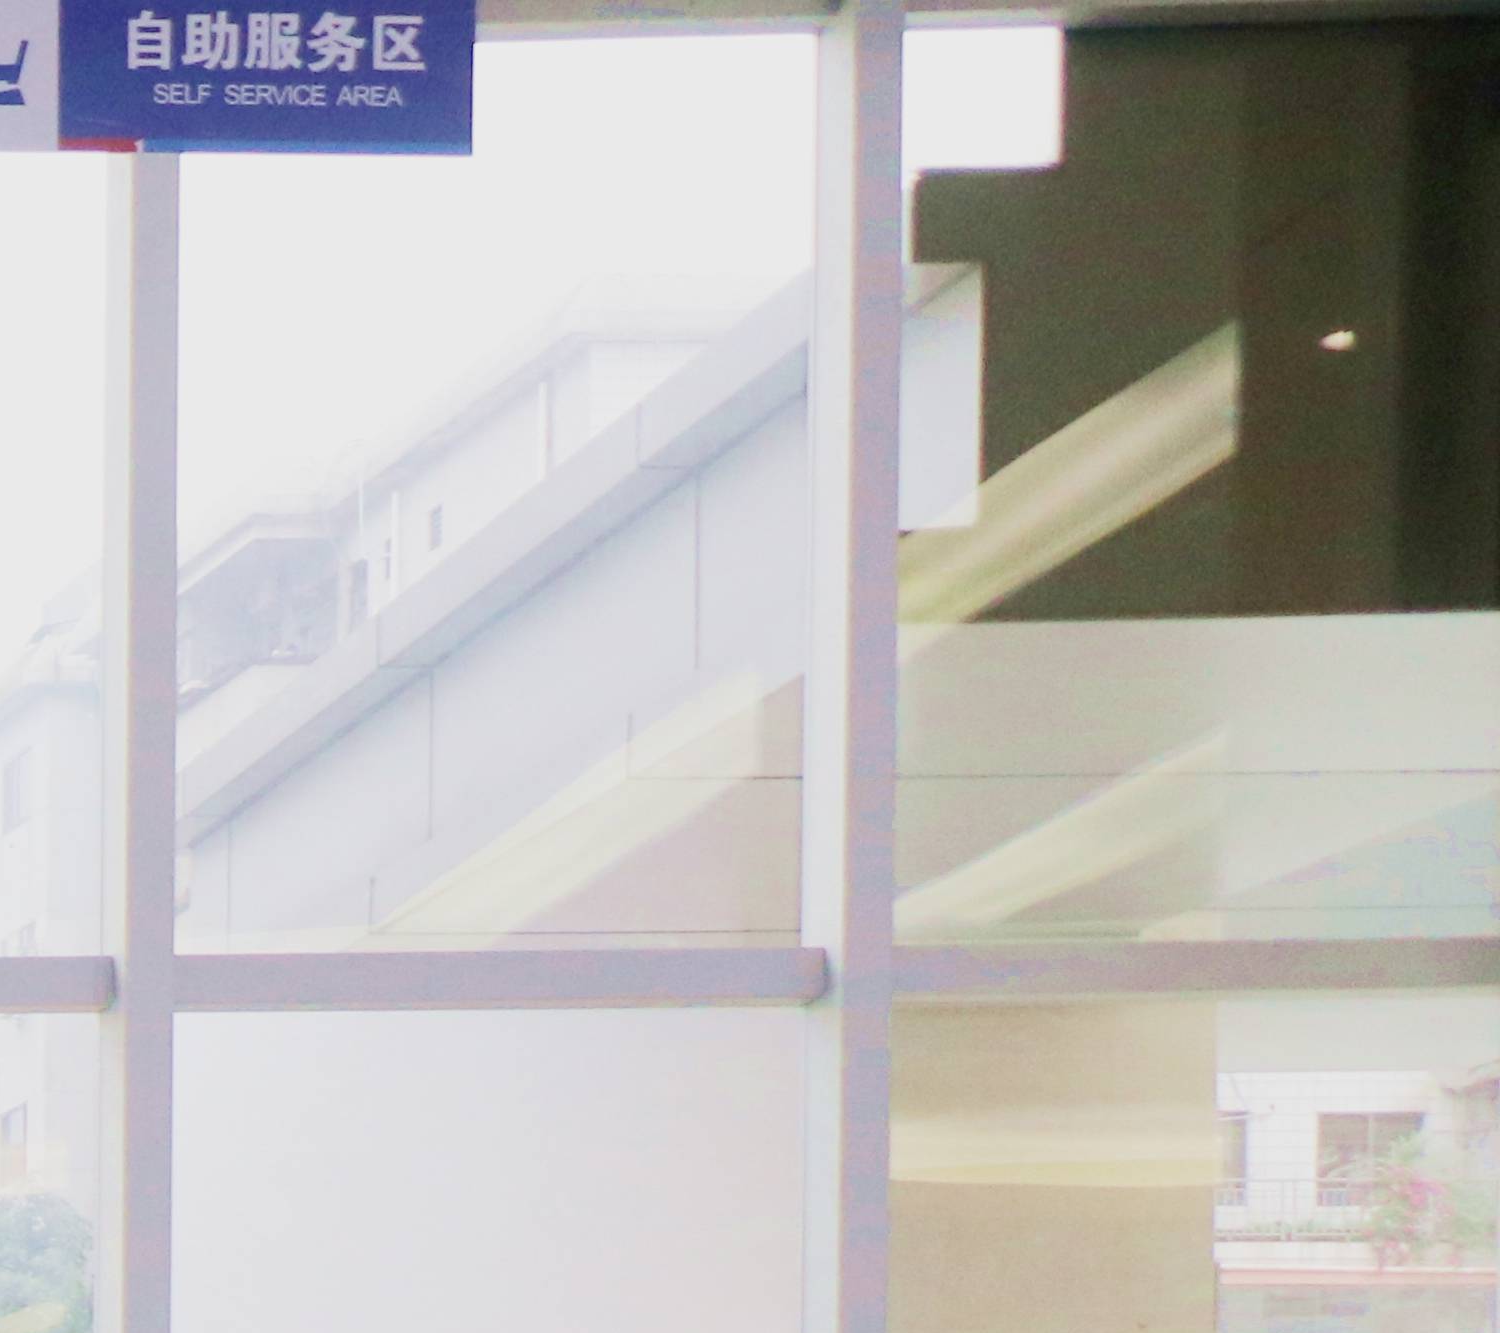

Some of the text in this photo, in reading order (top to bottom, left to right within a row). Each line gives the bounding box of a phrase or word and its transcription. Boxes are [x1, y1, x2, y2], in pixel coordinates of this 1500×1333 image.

[125, 11, 425, 72] 自助服务区
[153, 84, 403, 106] SELF SERVICE AREA
